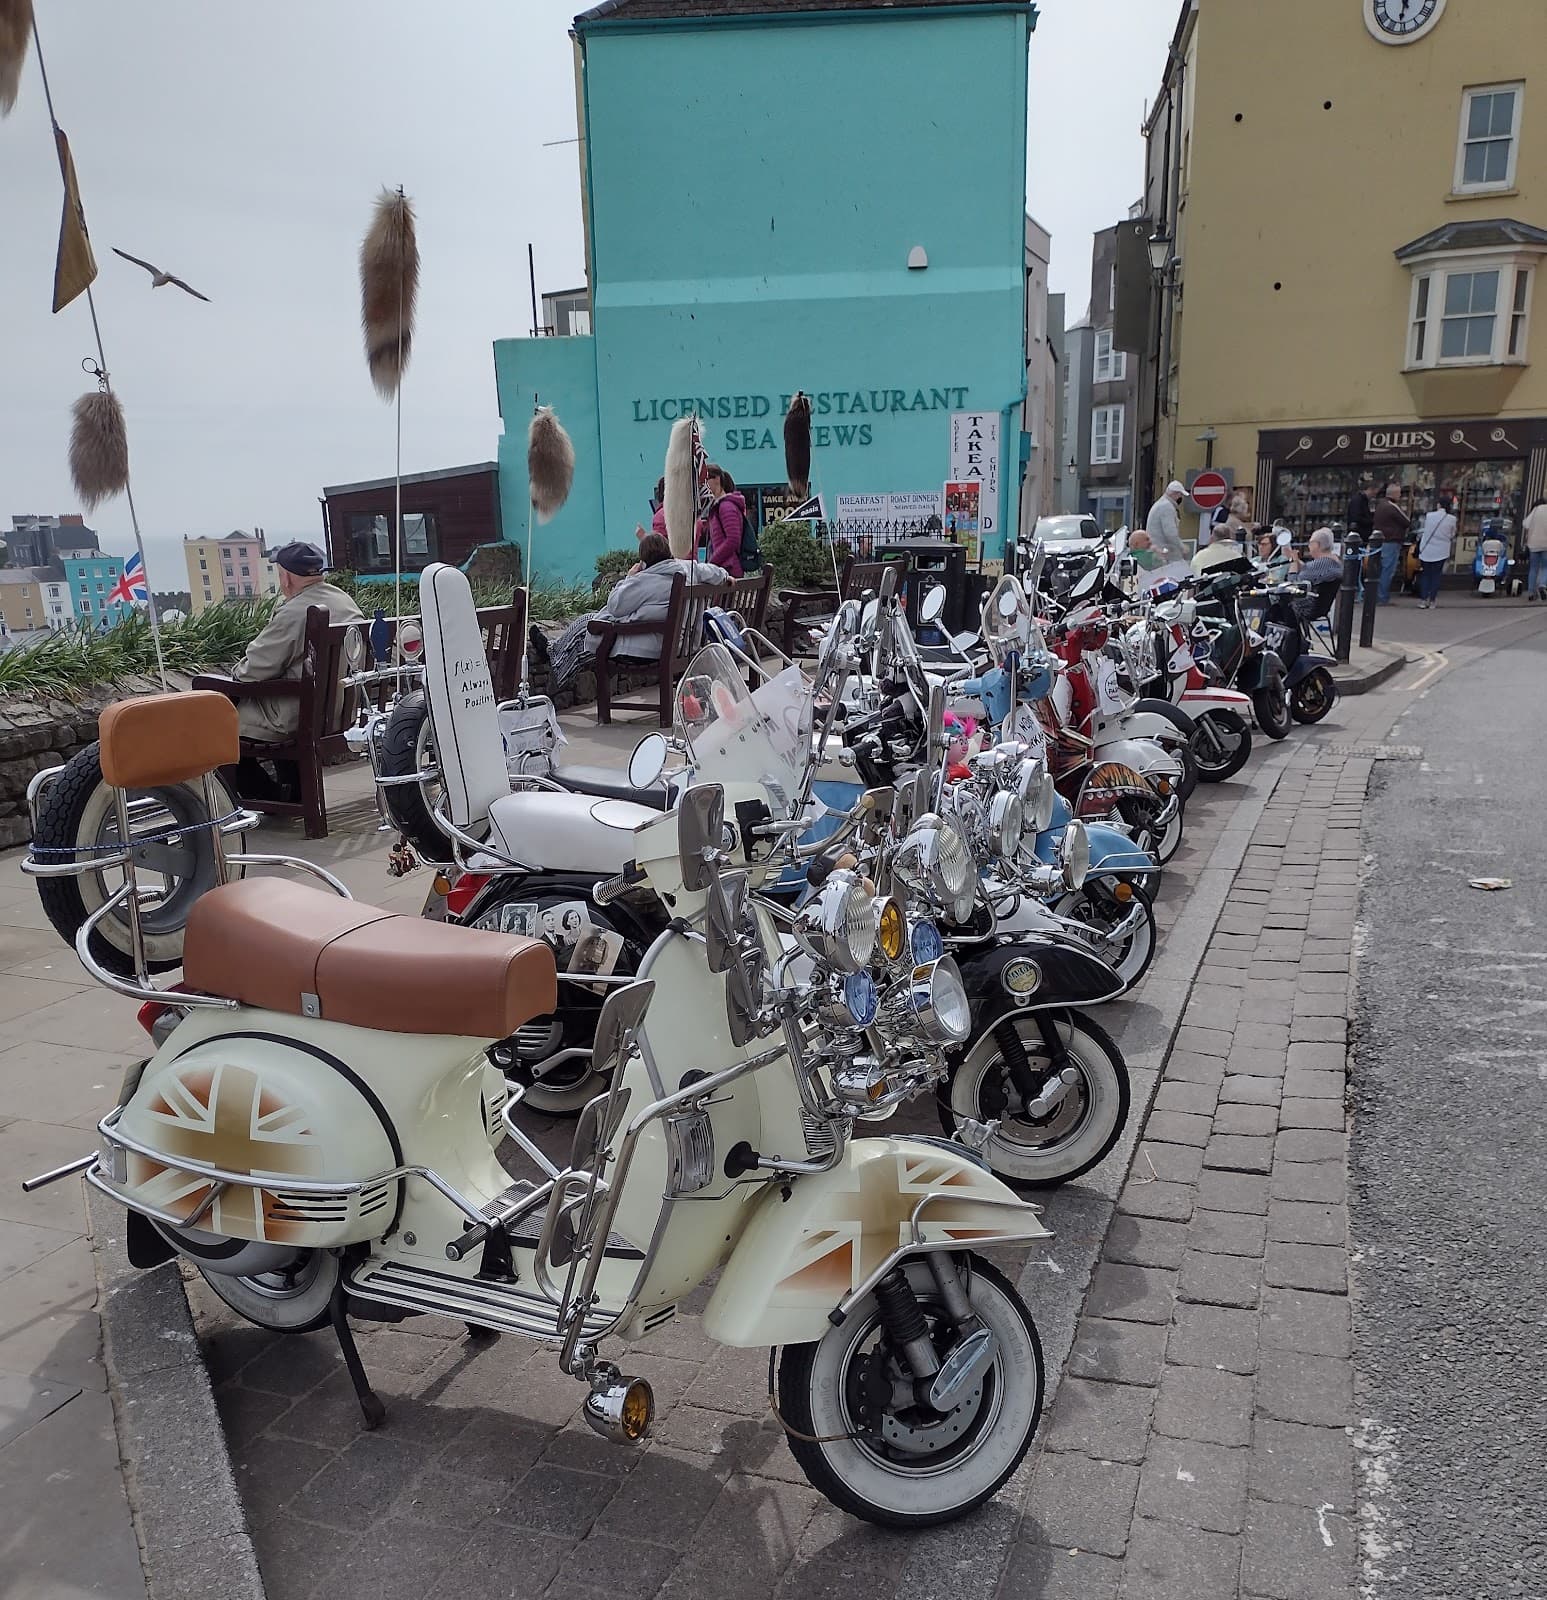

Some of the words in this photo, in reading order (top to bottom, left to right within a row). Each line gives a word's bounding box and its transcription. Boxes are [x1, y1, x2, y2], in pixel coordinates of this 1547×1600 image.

[632, 395, 770, 422] LICENSED
[725, 428, 778, 451] SEA
[1364, 430, 1436, 452] LOLLIES
[762, 495, 784, 504] TAKE
[839, 496, 885, 505] BREAKFAST
[890, 494, 911, 504] ROAST
[912, 494, 940, 503] DINNERS
